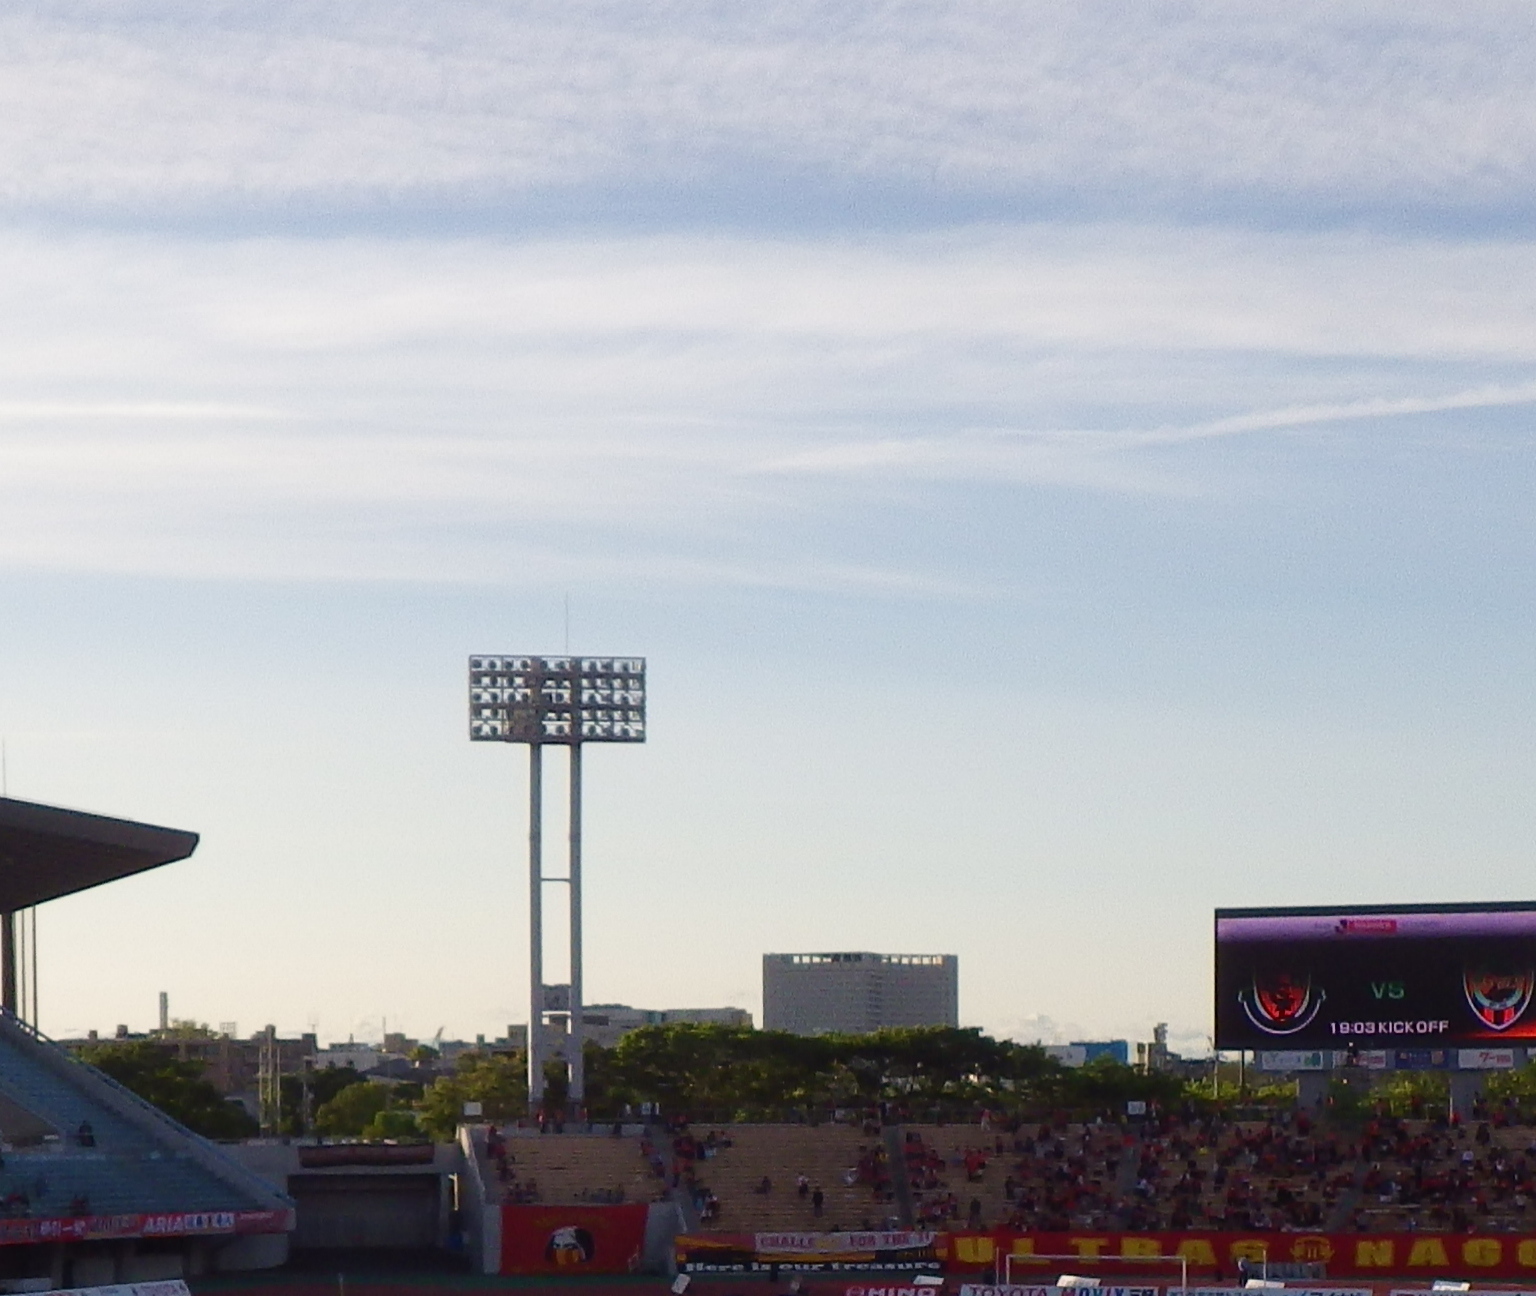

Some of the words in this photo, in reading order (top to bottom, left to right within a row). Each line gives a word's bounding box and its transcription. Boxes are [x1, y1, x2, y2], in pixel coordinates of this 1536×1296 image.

[1378, 1020, 1414, 1034] KICK
[1416, 1020, 1449, 1033] OFF
[954, 1236, 1270, 1266] ULTRAS
